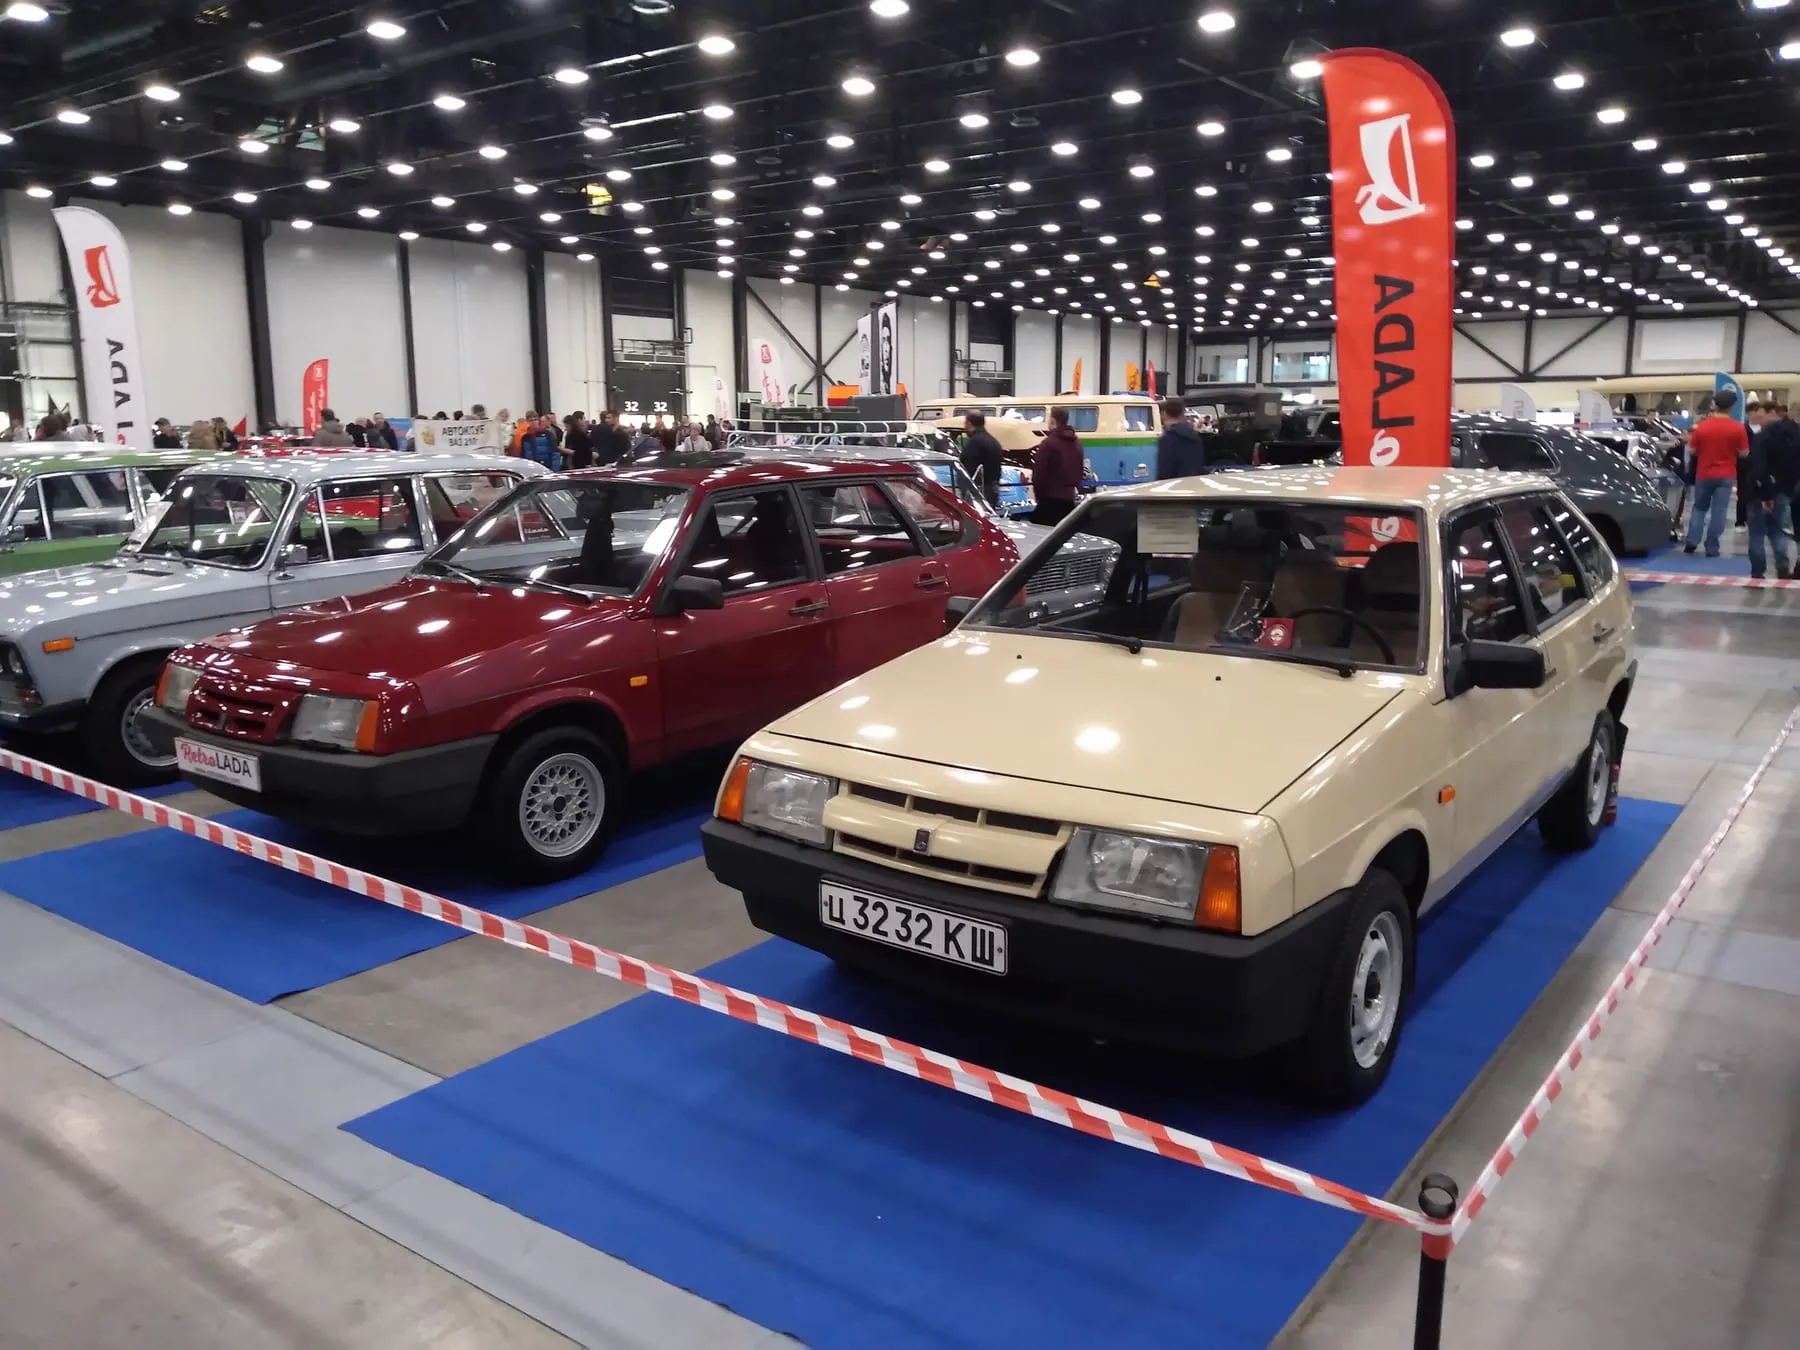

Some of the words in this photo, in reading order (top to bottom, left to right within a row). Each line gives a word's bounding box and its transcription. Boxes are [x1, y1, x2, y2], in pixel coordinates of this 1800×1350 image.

[624, 401, 639, 412] 32
[653, 401, 668, 412] 32
[853, 895, 933, 949] 3232
[944, 918, 994, 967] КШ
